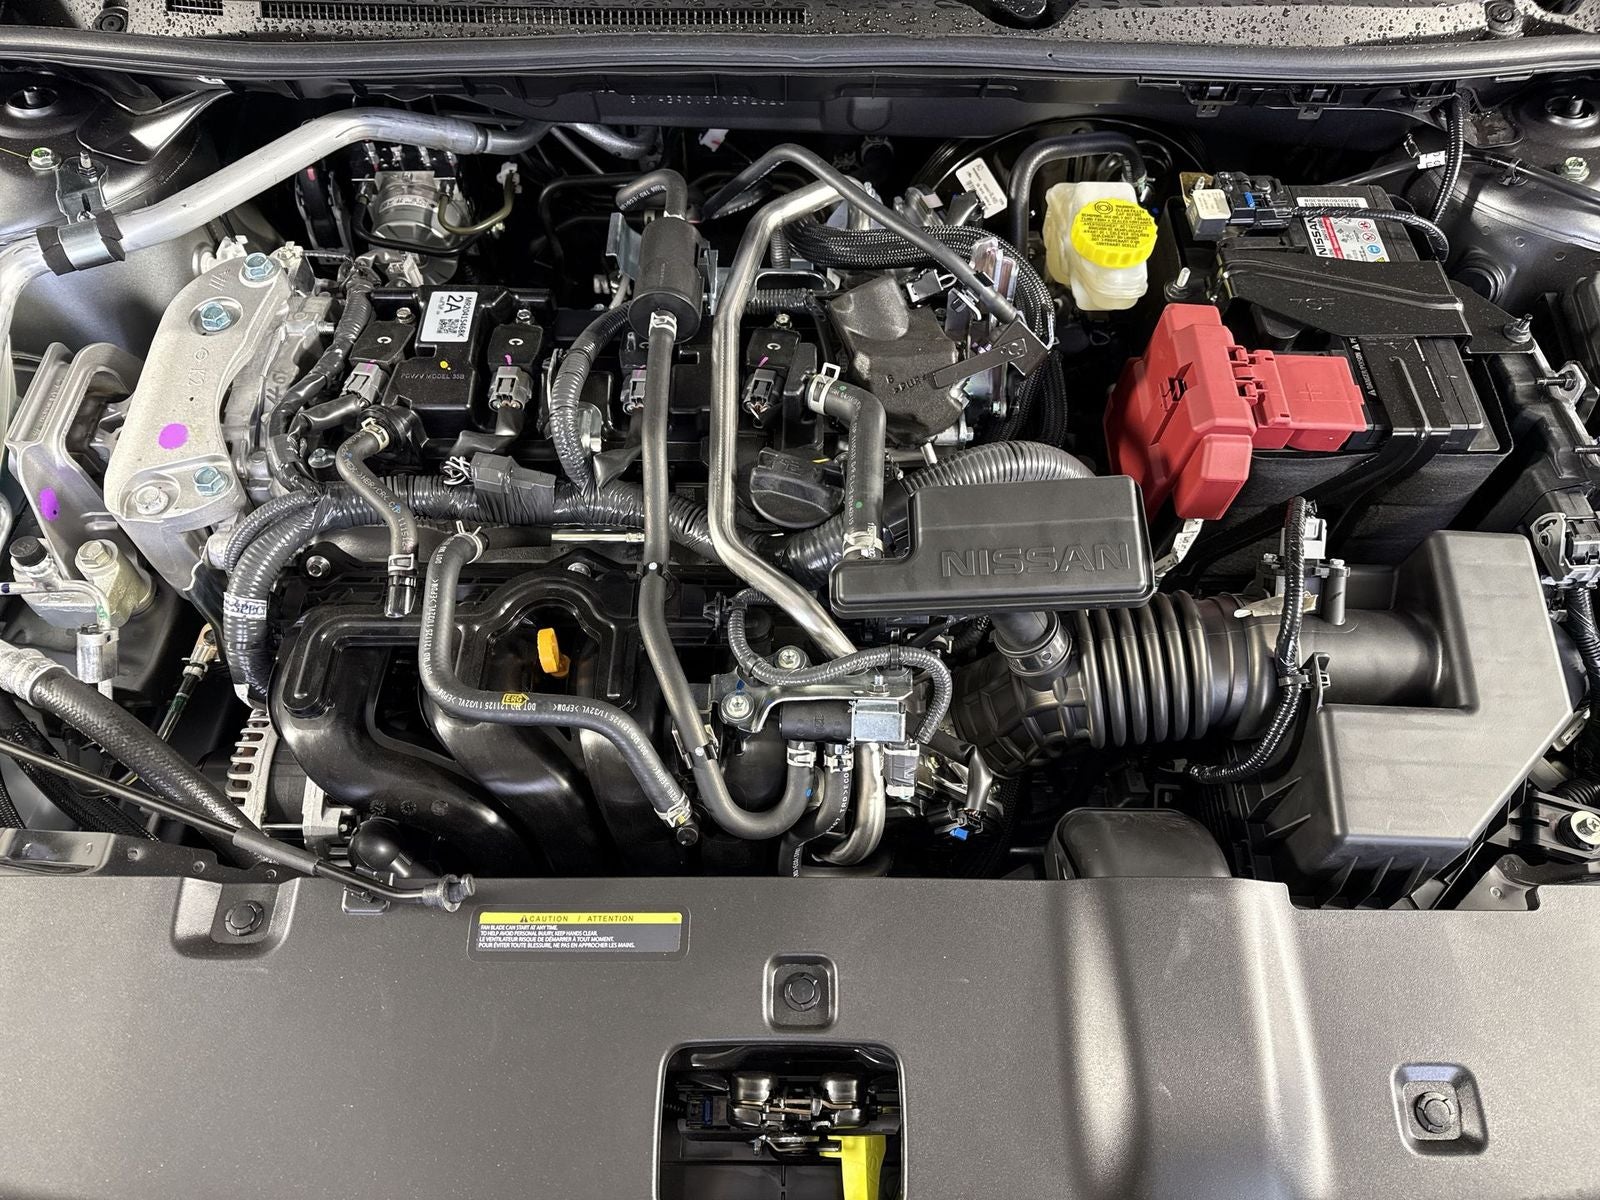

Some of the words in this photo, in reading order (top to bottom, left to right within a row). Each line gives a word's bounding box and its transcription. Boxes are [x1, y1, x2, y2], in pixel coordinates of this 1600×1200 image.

[1308, 216, 1328, 256] NISSAN
[444, 294, 464, 314] 2A
[940, 543, 1131, 577] NISSAN
